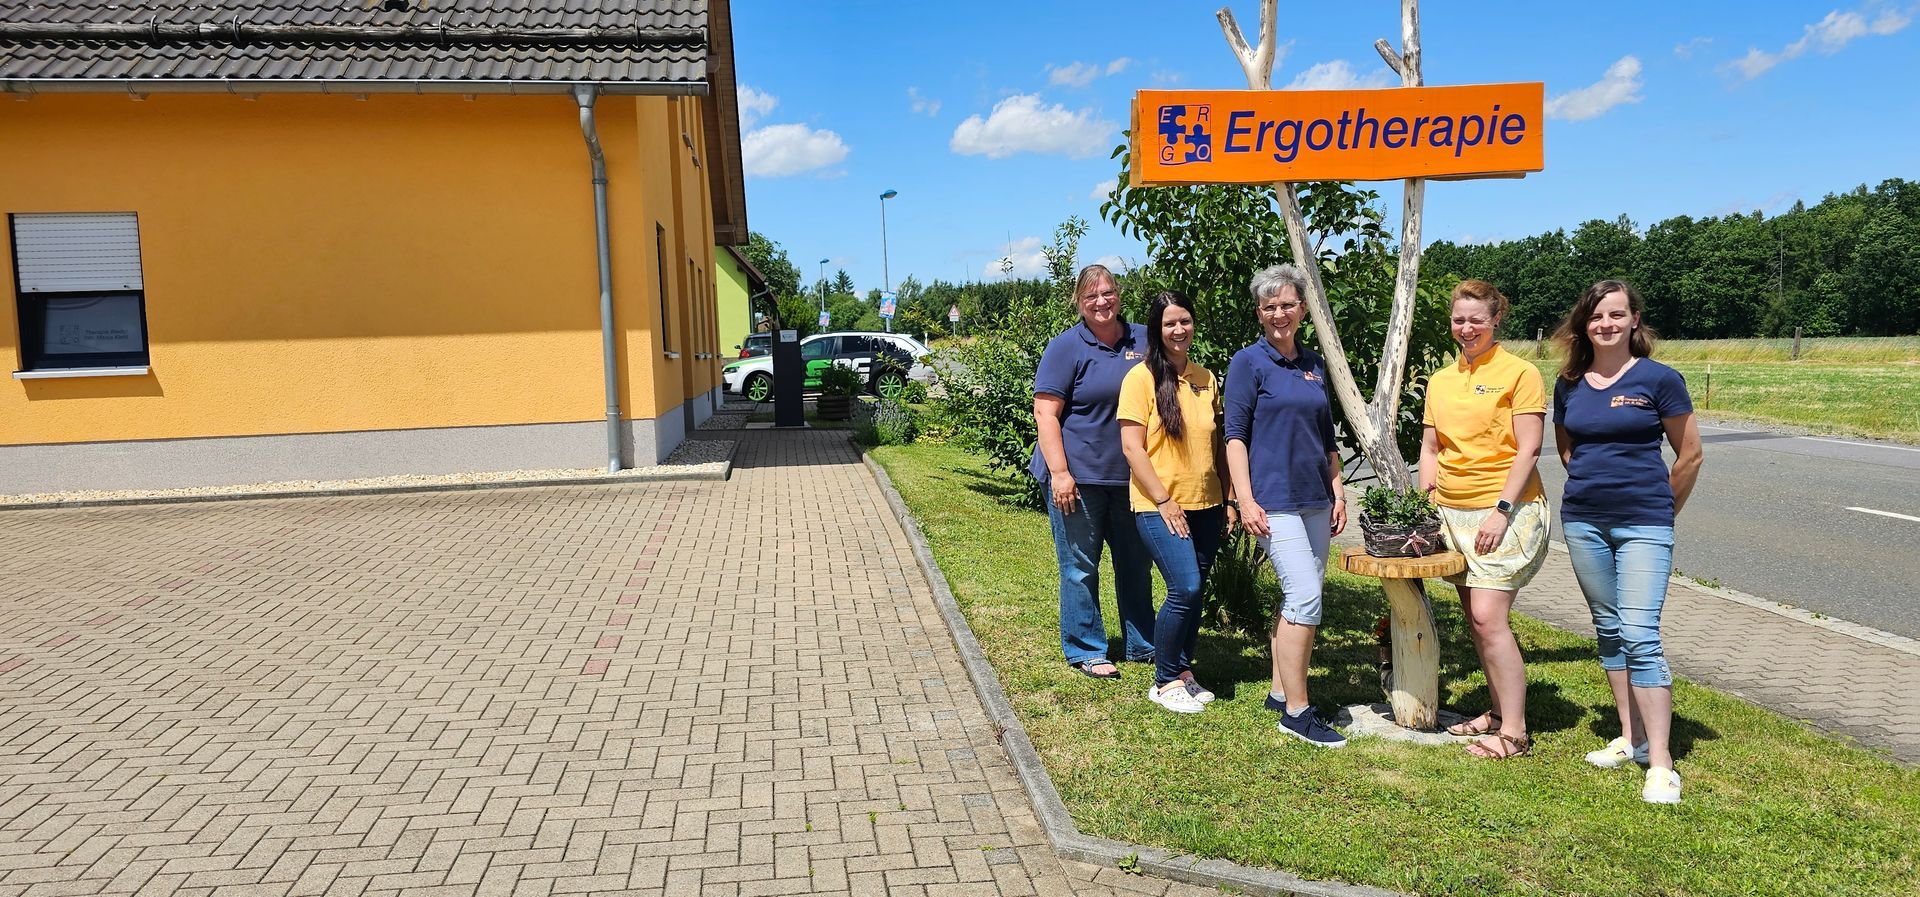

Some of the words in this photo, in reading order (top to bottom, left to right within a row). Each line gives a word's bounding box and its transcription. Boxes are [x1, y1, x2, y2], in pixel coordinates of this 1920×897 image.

[1160, 106, 1173, 123] E
[1197, 106, 1210, 122] R
[1224, 104, 1526, 163] Ergotherapie
[1161, 145, 1175, 162] G
[1196, 144, 1210, 161] O
